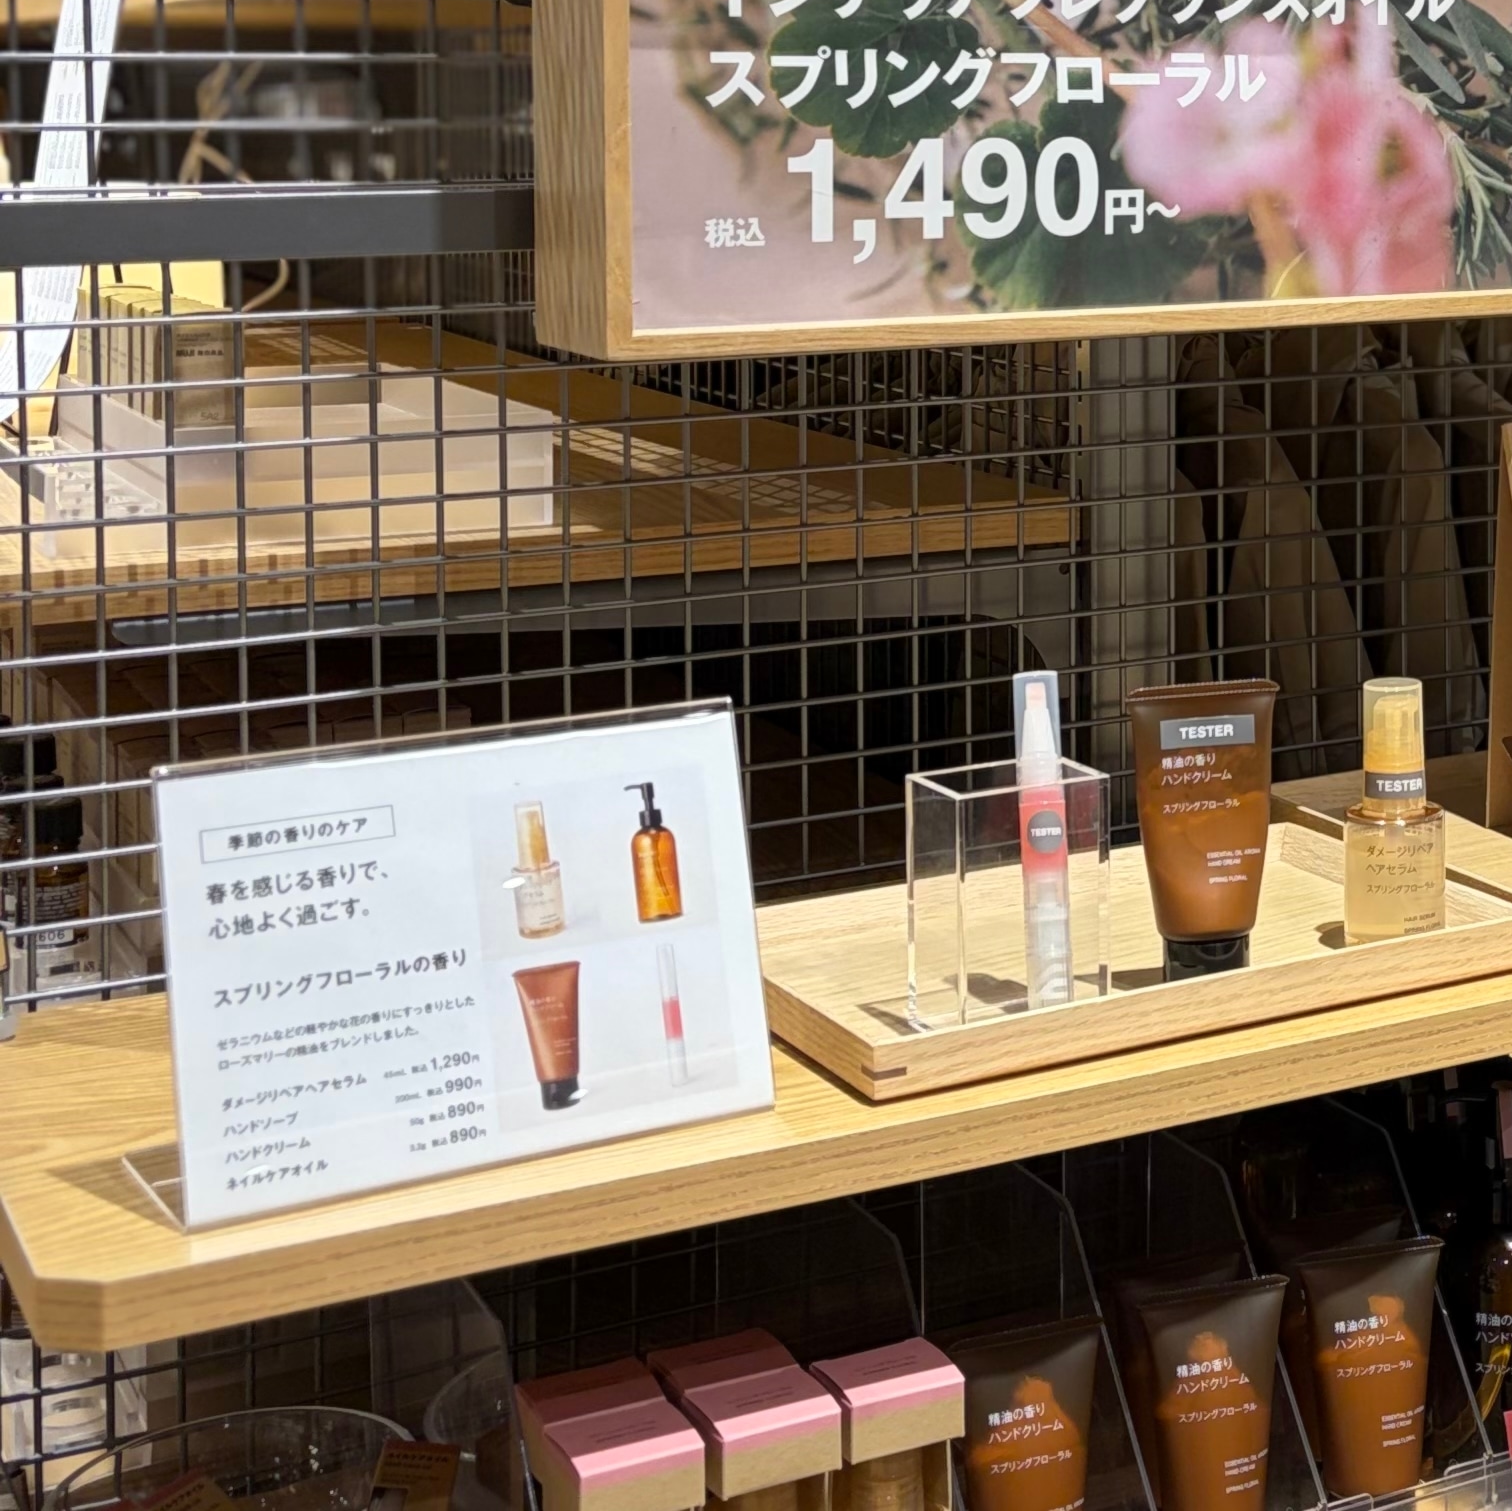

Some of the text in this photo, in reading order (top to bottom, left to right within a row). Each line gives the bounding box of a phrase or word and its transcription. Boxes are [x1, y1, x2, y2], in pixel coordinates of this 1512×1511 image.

[705, 45, 1267, 110] スプリングフローラル
[704, 216, 766, 249] 税込
[1178, 724, 1235, 740] TESTER
[1161, 752, 1217, 770] 精油の香り
[1160, 768, 1233, 787] ハンドクリーム
[1376, 777, 1423, 793] TESTER
[1162, 797, 1241, 815] スプリングフローラル
[227, 817, 368, 852] 季節の香りのケア
[1030, 826, 1062, 838] TESTER
[1366, 842, 1434, 858] ダメージリペア
[1365, 863, 1417, 876] ヘアセラム
[205, 860, 389, 906] 春を感じる香りで、
[1366, 881, 1435, 895] スプリングフローラル
[208, 898, 370, 940] 心地よく過ごす。
[213, 948, 468, 1009] スプリングフローラルの香り
[222, 1073, 368, 1112] ダメージリペアヘアセラム
[430, 1051, 480, 1073] 1,290円
[223, 1111, 299, 1138] ハンドソープ
[445, 1076, 483, 1094] 990円
[225, 1136, 312, 1164] ハンドクリーム
[447, 1100, 485, 1119] 890円
[226, 1159, 329, 1191] ネイルケアオイル
[449, 1125, 487, 1144] 890円
[1334, 1314, 1390, 1335] 精油の香り
[1334, 1331, 1406, 1351] ハンドクリーム
[1176, 1356, 1234, 1379] 精油の香り
[1336, 1359, 1414, 1379] スプリングフローラル
[1176, 1373, 1250, 1396] ハンドクリーム
[988, 1403, 1046, 1428] 精油の香り
[1178, 1402, 1258, 1425] スプリングフローラル
[988, 1419, 1064, 1445] ハンドクリーム
[990, 1449, 1073, 1475] スプリングフローラル
